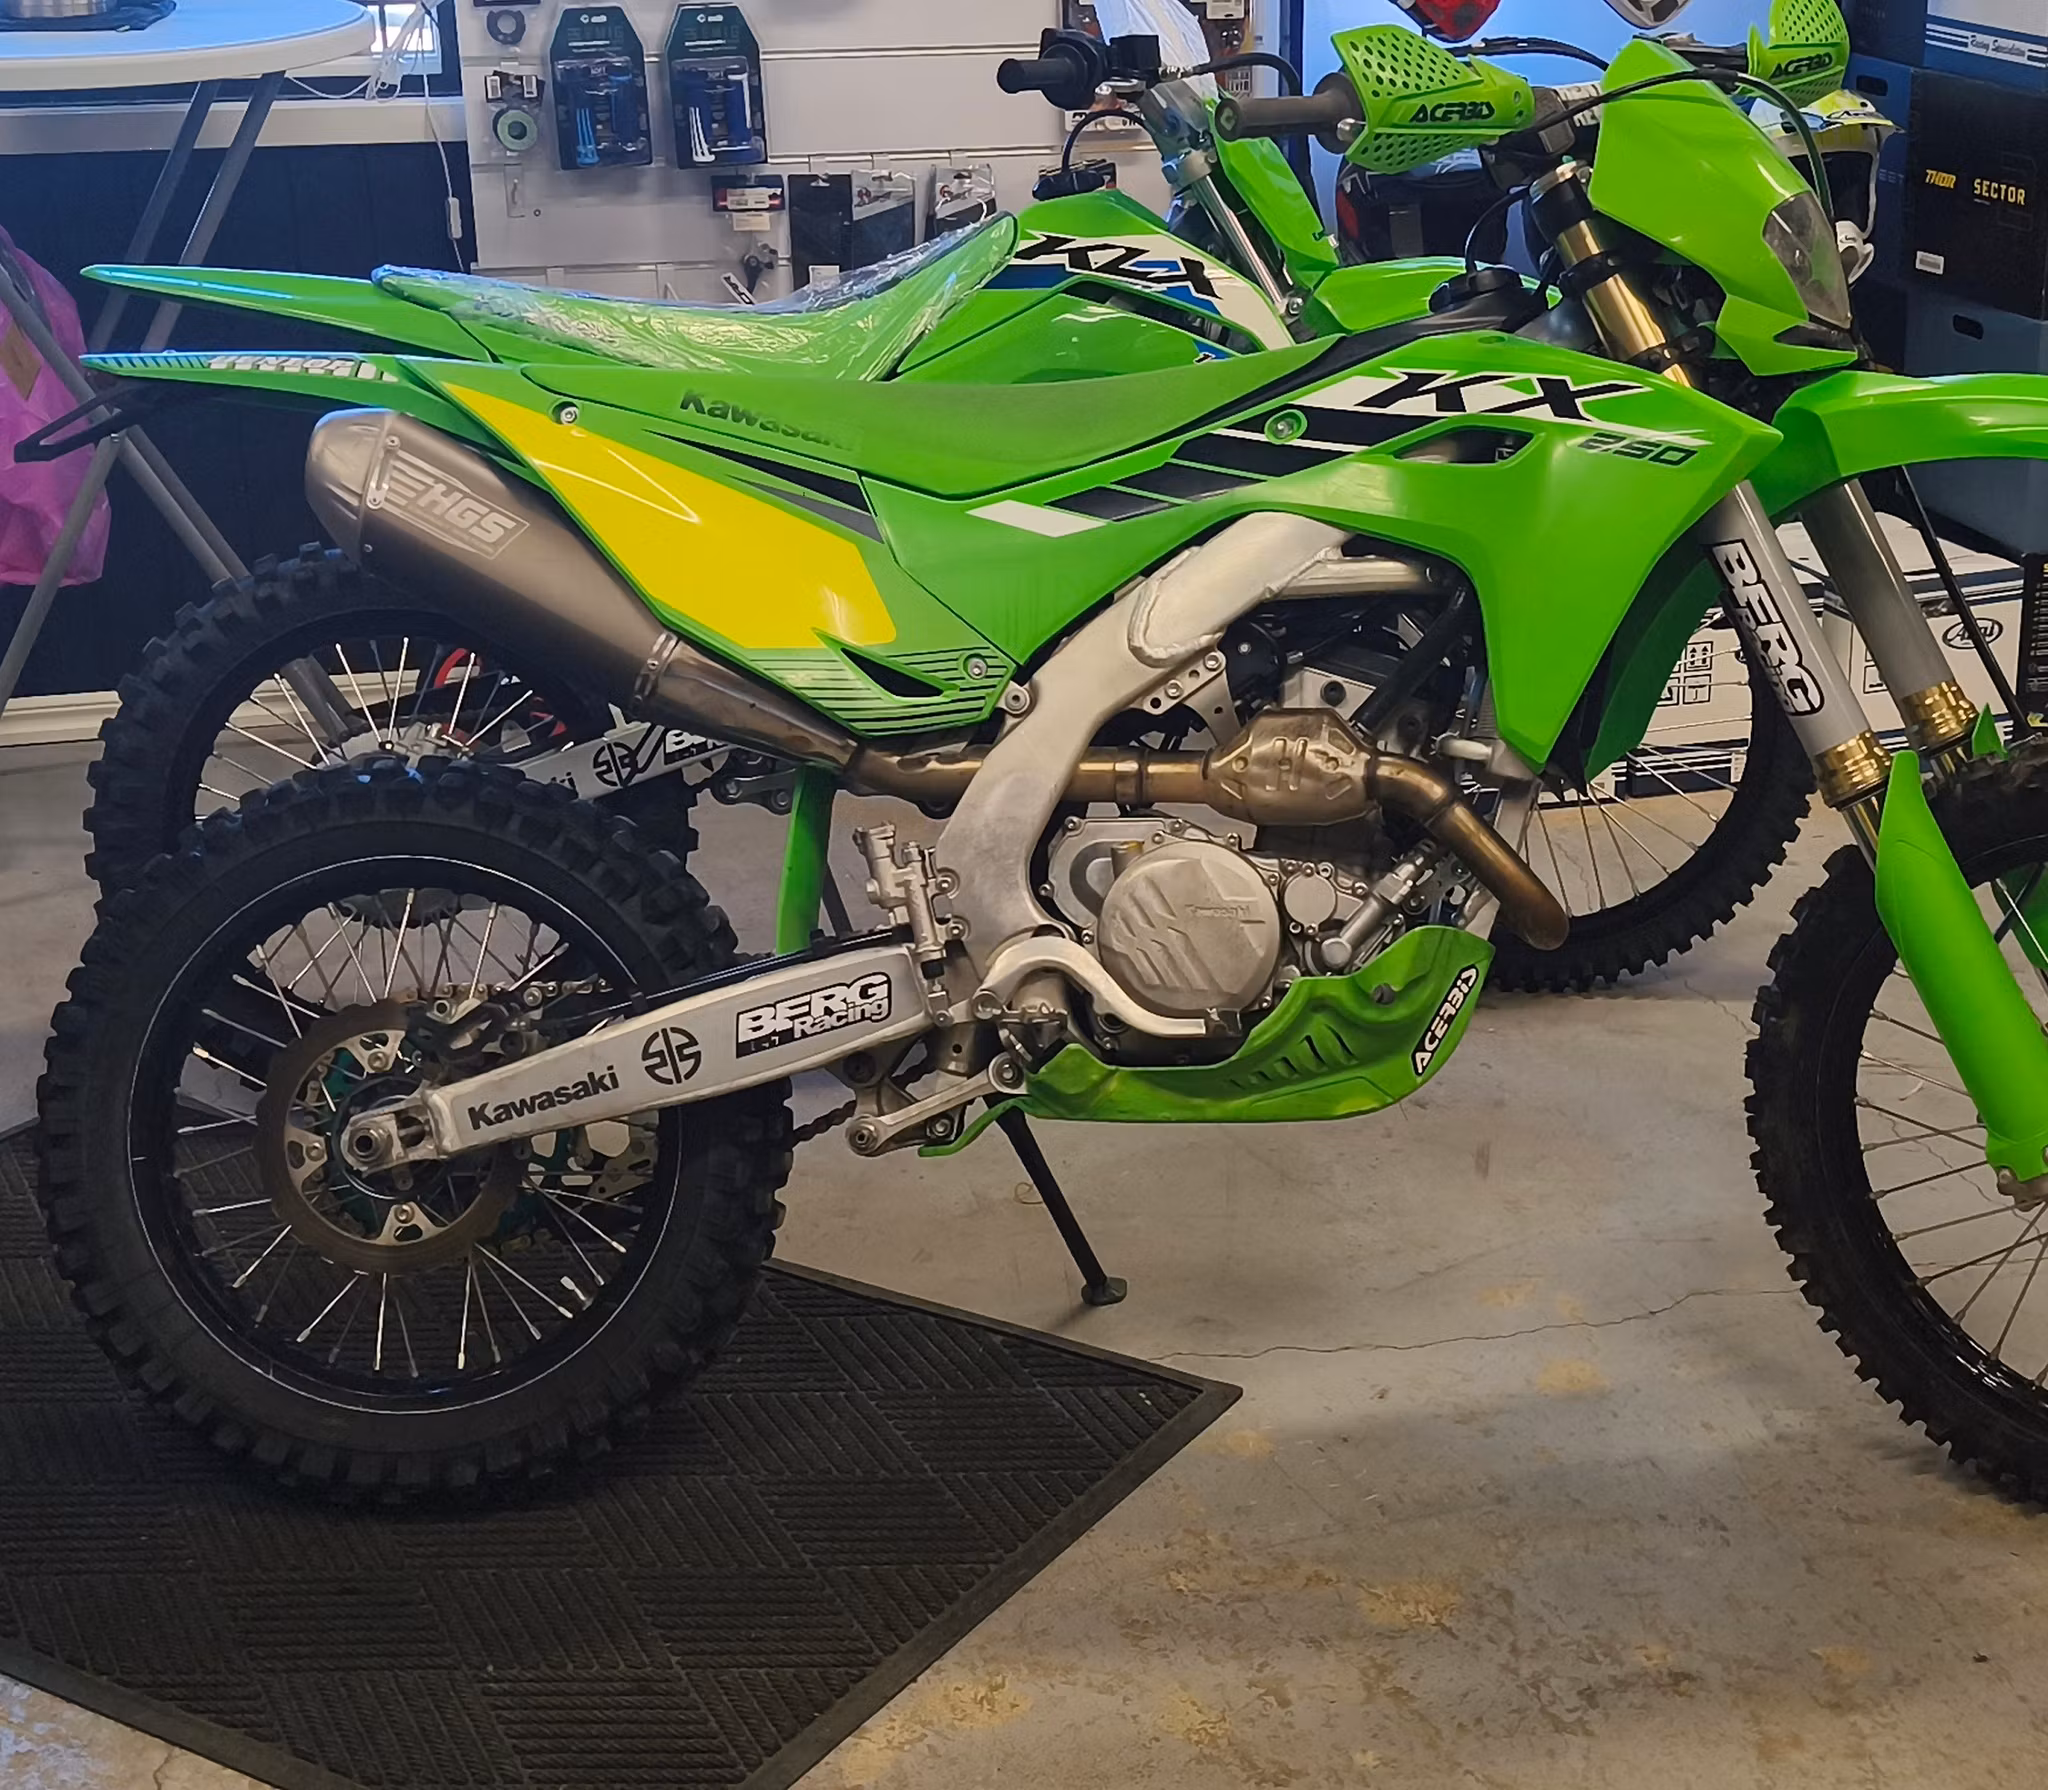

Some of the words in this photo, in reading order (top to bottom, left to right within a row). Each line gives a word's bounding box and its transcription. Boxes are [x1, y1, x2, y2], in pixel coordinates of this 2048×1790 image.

[1924, 168, 1957, 189] THOR
[1973, 178, 2026, 206] SECTOR
[1353, 371, 1644, 422] KX
[1576, 432, 1699, 467] 250
[415, 482, 517, 544] HGS
[1712, 539, 1823, 714] BERG
[737, 973, 889, 1043] BERG
[793, 998, 889, 1038] Racing
[1414, 967, 1478, 1074] ACERBIS
[467, 1065, 620, 1131] Kawasaki
